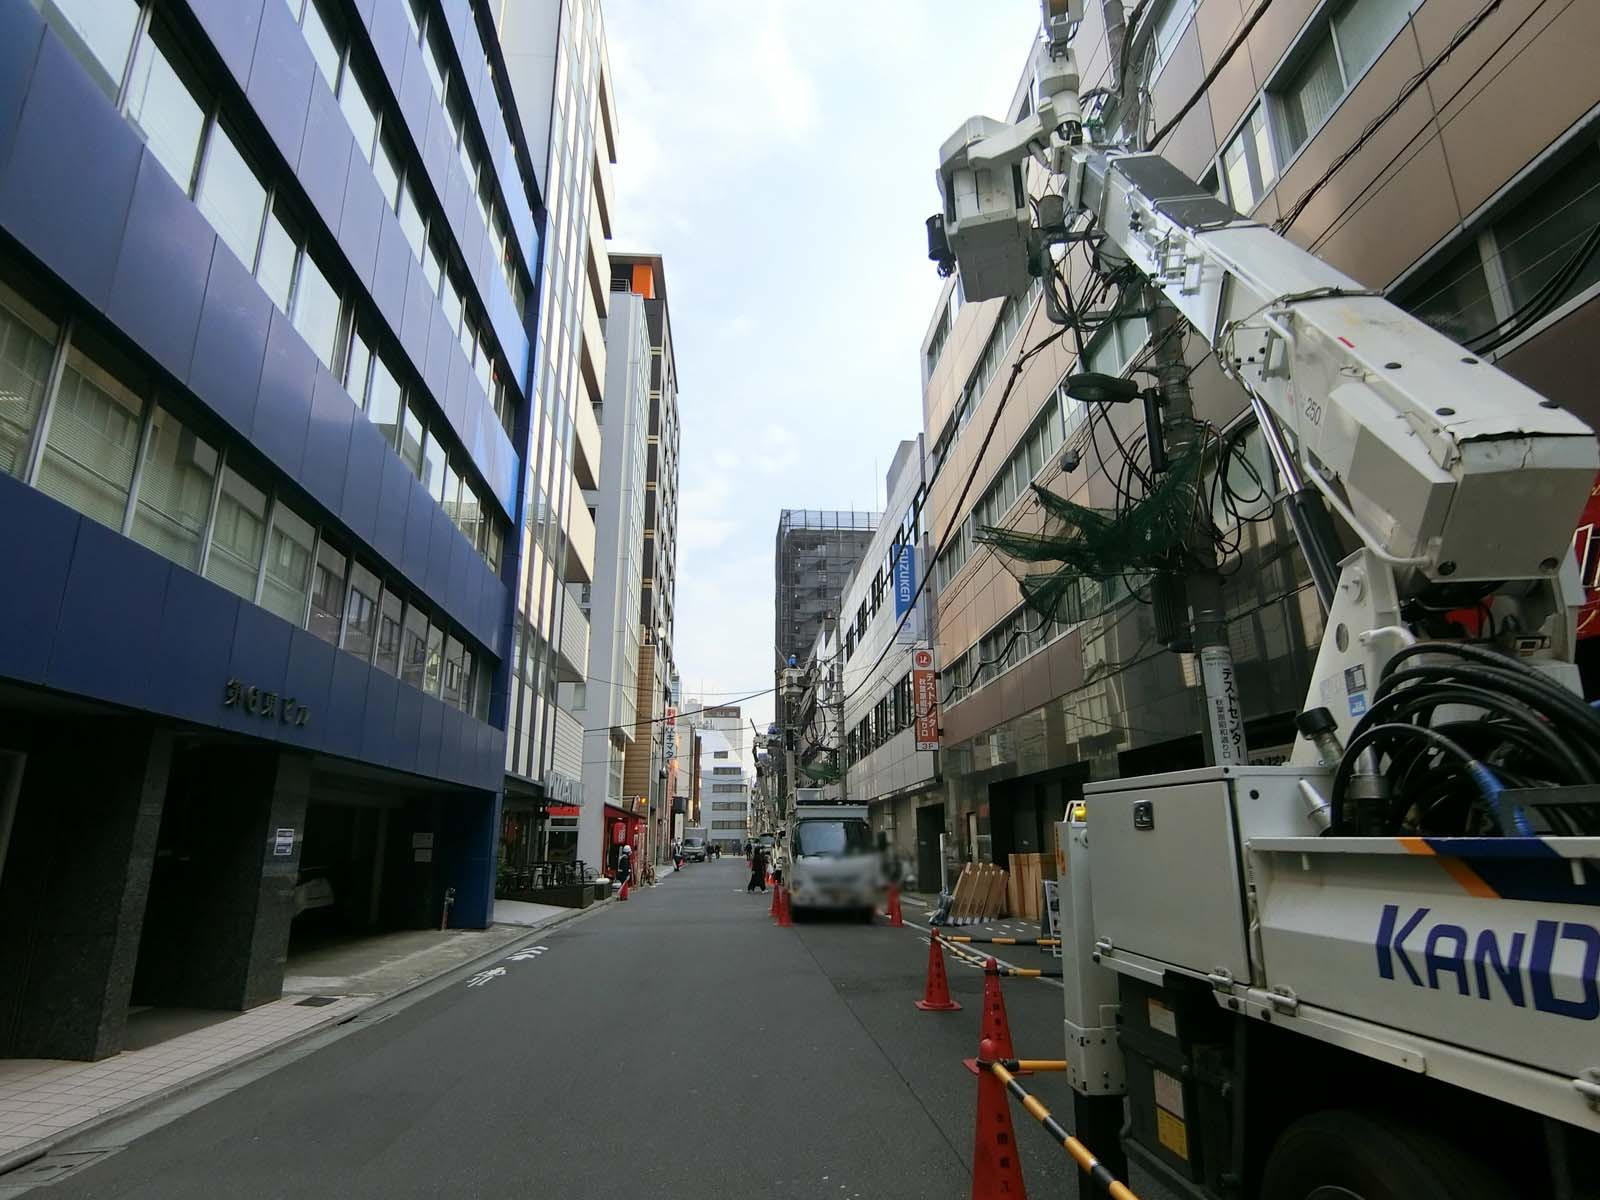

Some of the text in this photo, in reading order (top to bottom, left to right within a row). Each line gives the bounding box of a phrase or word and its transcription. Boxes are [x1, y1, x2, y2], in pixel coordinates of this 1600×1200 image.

[1305, 397, 1322, 426] 250
[1222, 667, 1242, 760] テストセンター
